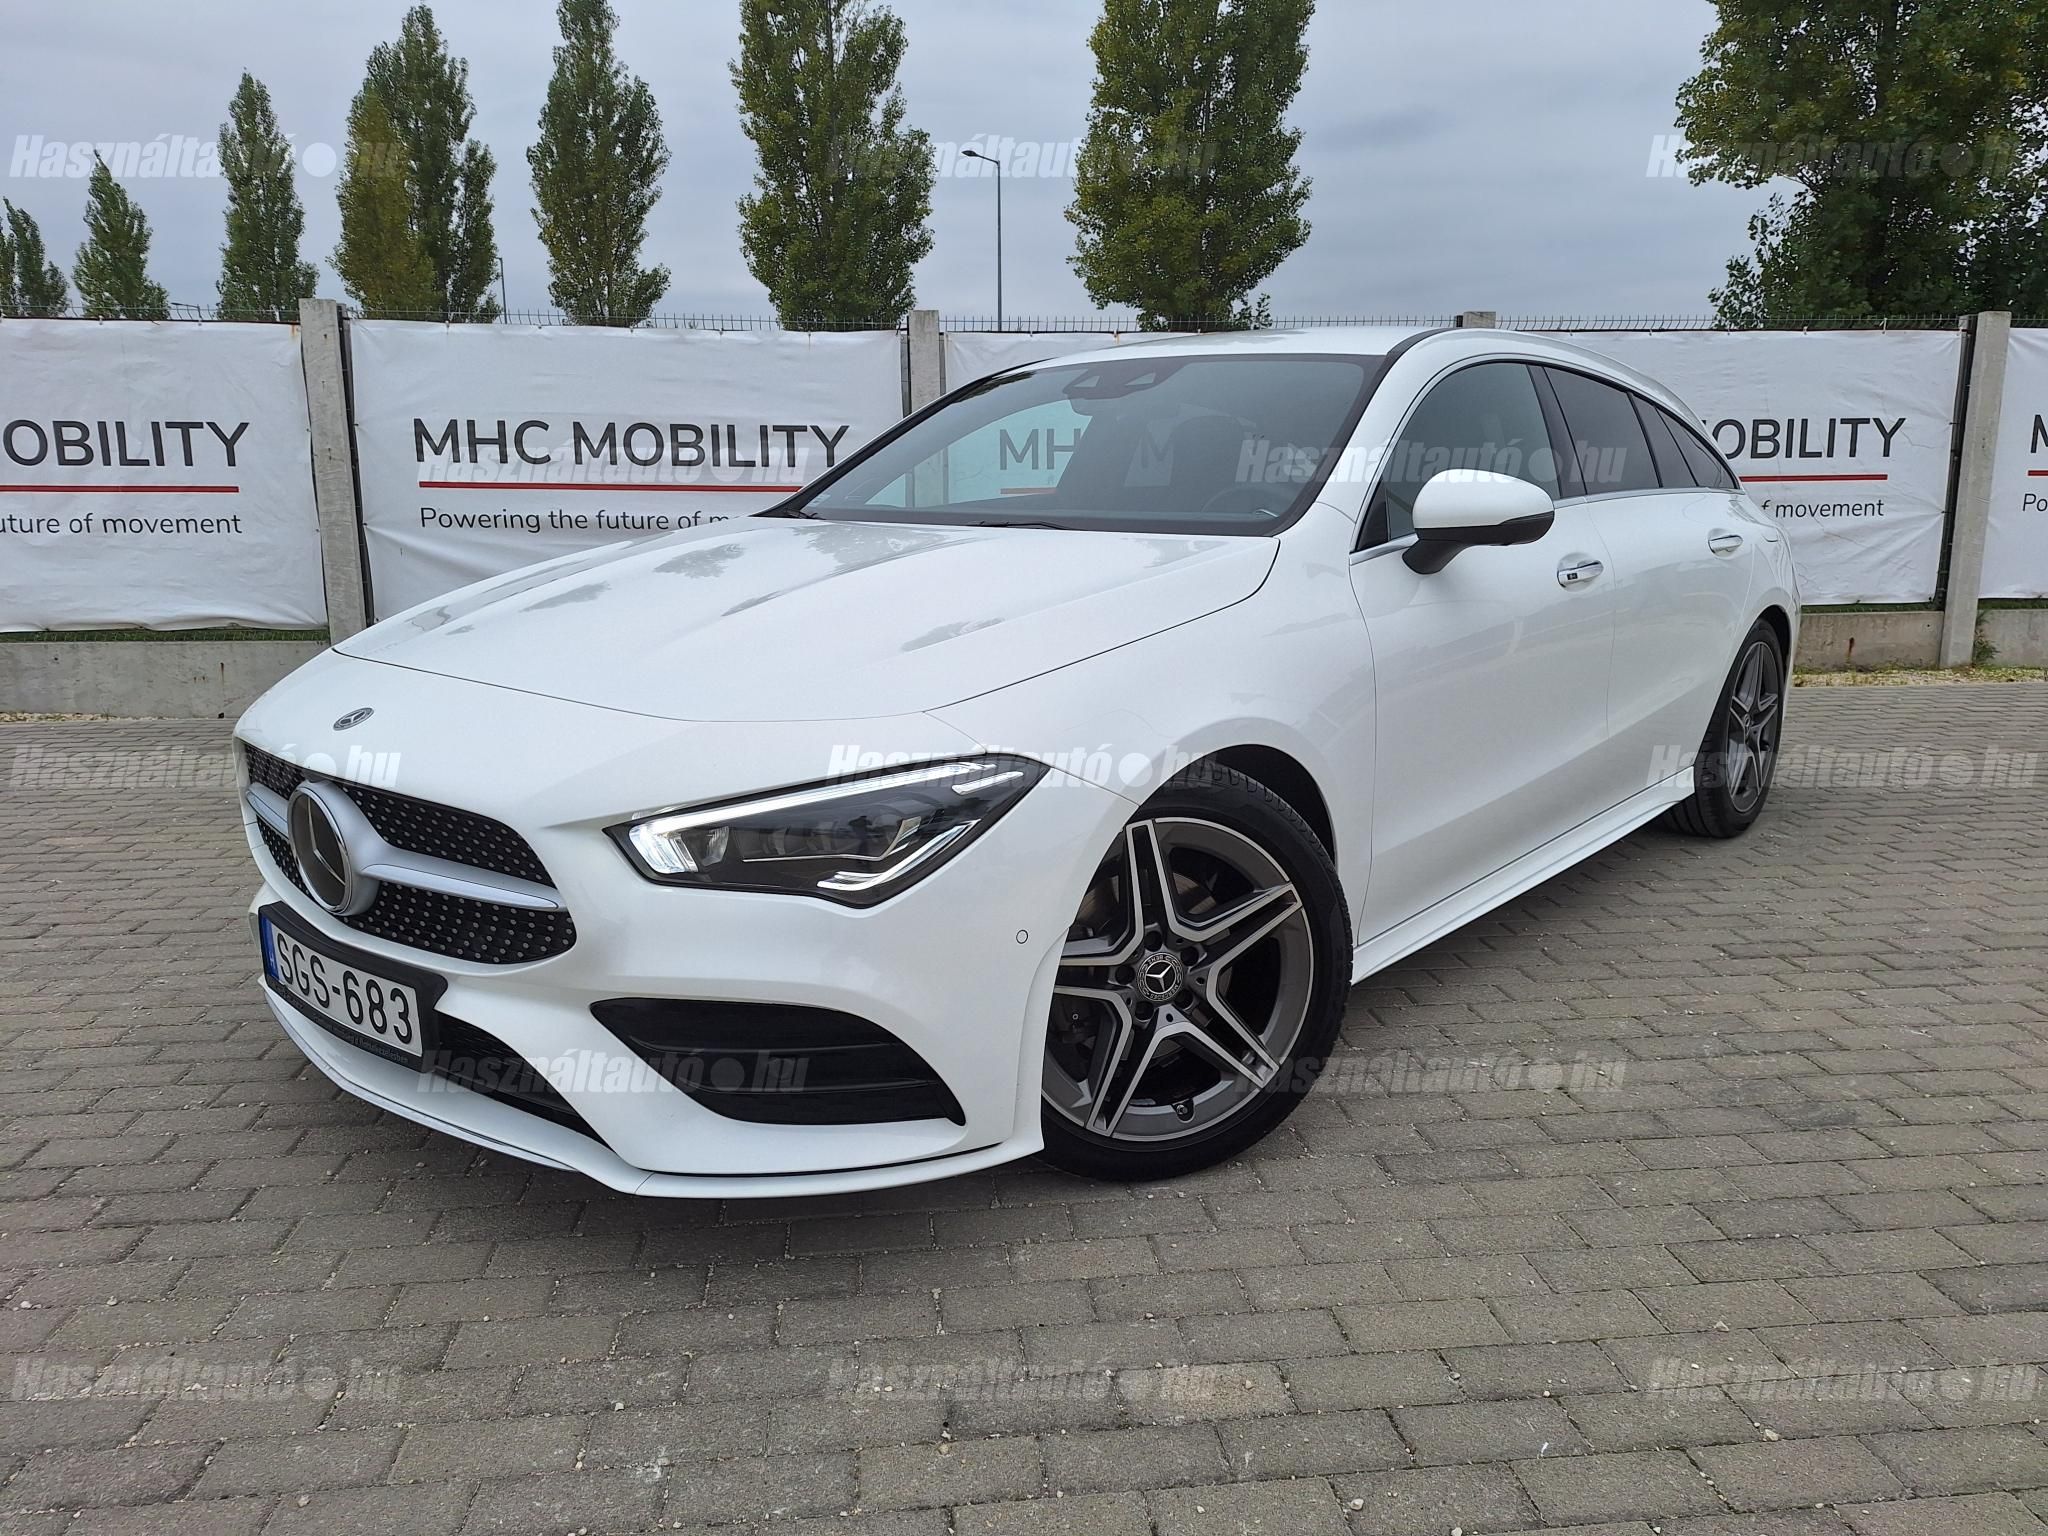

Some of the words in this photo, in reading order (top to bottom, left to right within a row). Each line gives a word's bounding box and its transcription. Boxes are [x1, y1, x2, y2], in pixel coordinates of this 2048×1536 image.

[414, 418, 551, 464] MHC
[573, 422, 849, 468] MOBILITY
[1000, 428, 1082, 471] MH
[1702, 417, 1906, 460] OBILITY
[69, 513, 93, 534] of
[102, 514, 243, 534] movement
[420, 507, 541, 534] Powering
[548, 509, 588, 530] the
[595, 509, 669, 531] future
[677, 511, 702, 529] of
[1775, 499, 1884, 518] movement
[277, 932, 413, 1045] SGS-683
